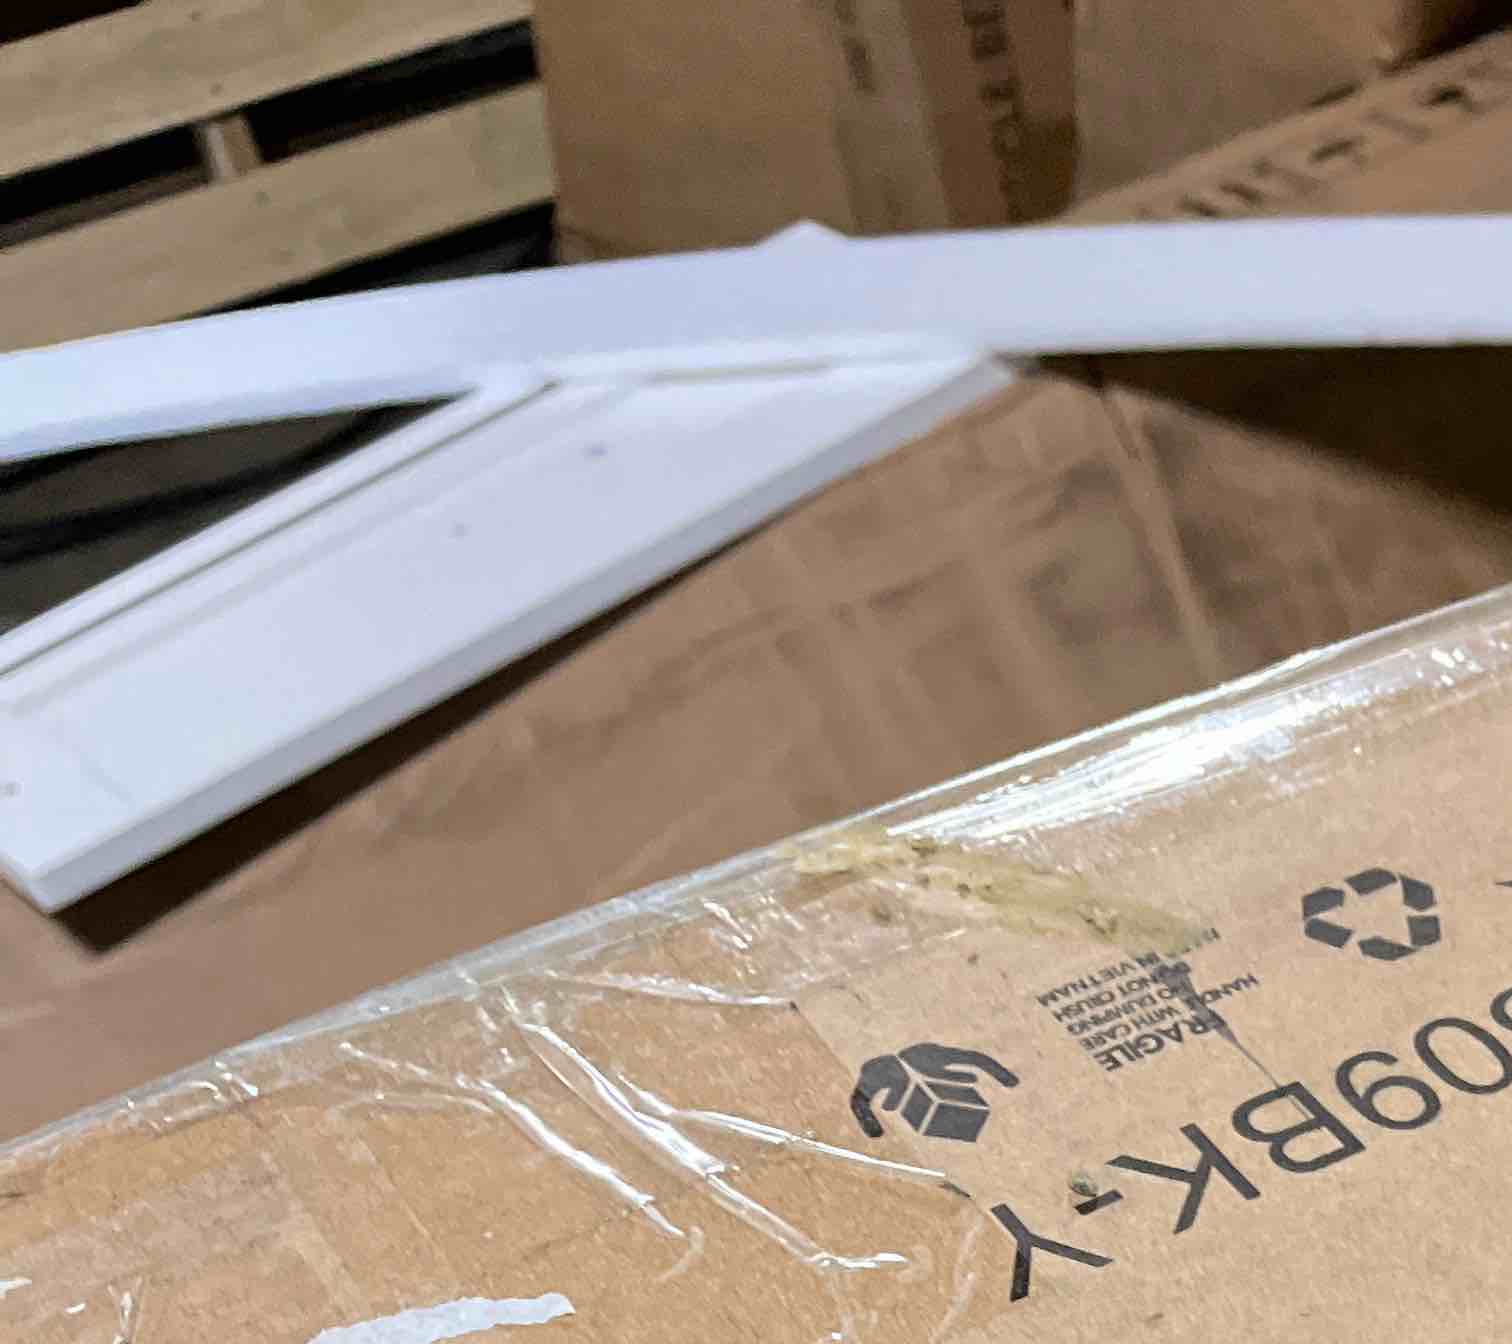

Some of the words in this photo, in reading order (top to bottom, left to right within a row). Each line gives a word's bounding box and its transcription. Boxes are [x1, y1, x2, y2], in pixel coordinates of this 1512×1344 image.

[1035, 960, 1137, 1007] VIETNAM
[1052, 989, 1116, 1023] CRUSH
[1066, 994, 1157, 1036] DUMPING
[1079, 1023, 1132, 1051] CARE
